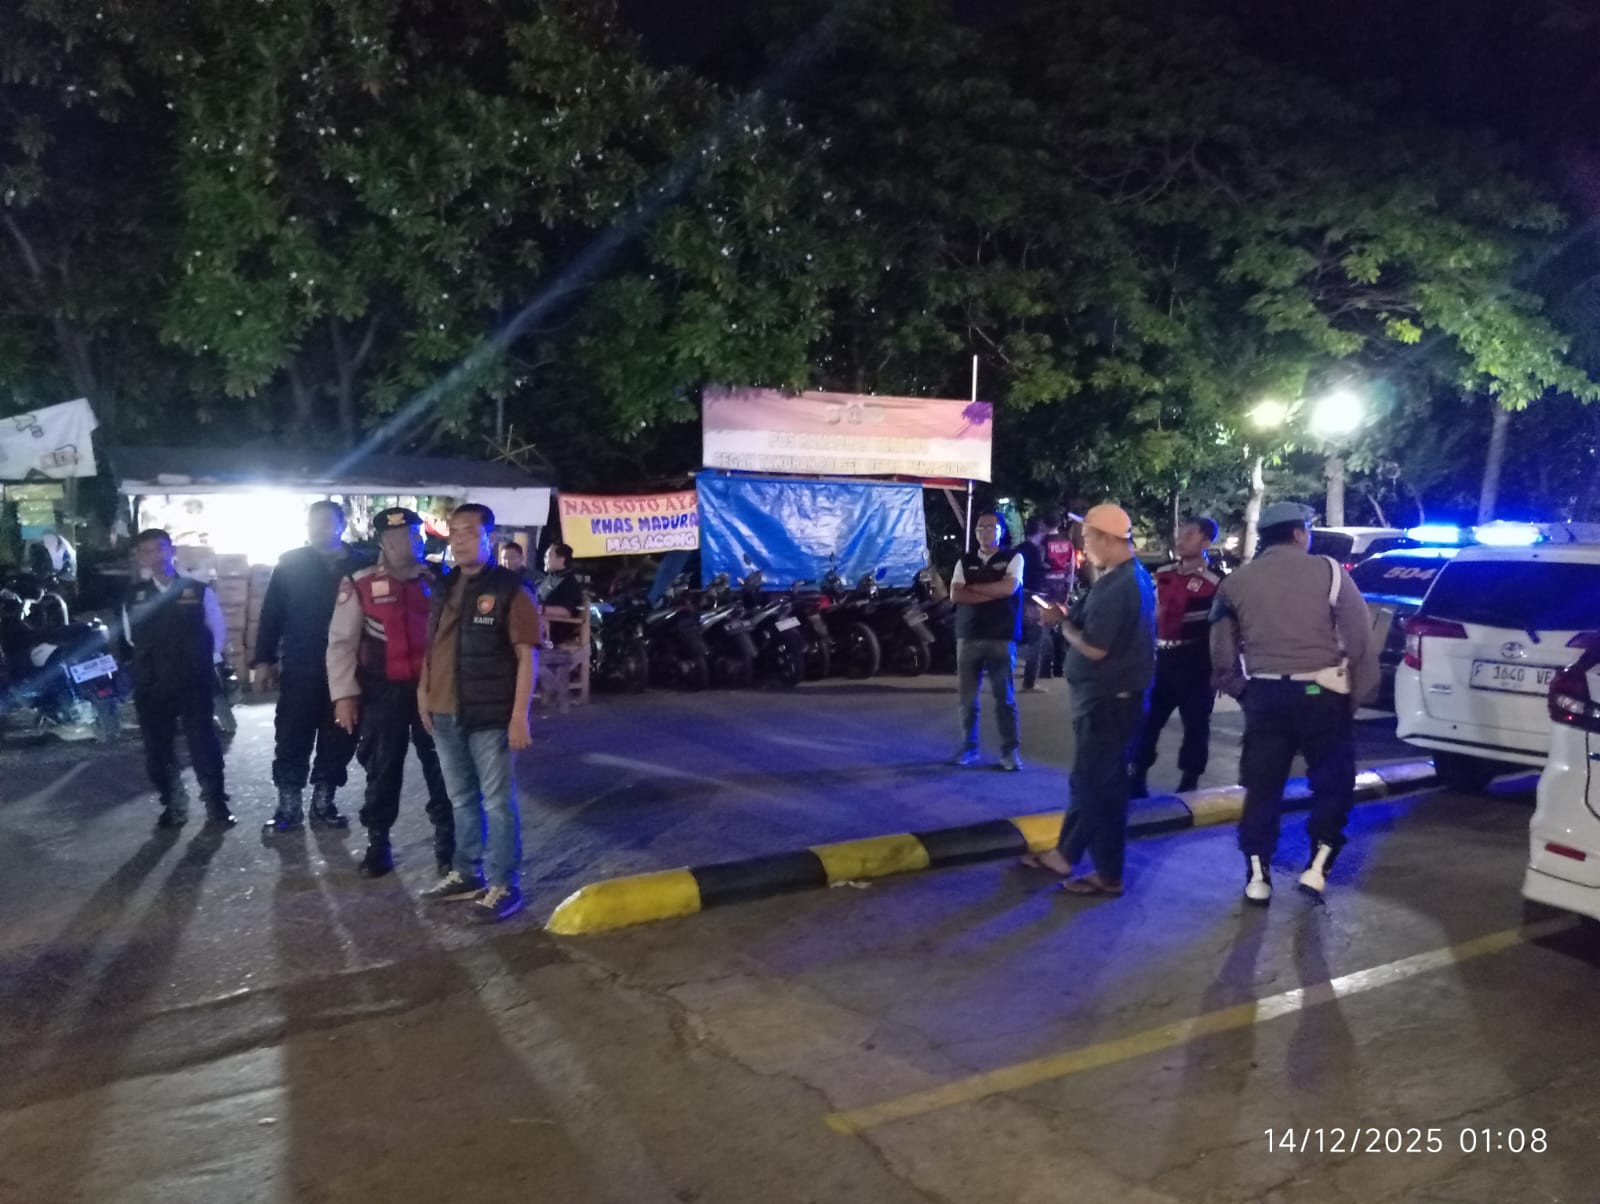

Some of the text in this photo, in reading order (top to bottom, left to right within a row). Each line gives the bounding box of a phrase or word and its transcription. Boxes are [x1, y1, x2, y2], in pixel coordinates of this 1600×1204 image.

[564, 500, 609, 515] NASI
[611, 499, 660, 513] SOTO
[590, 512, 698, 535] KHAS MADURA
[605, 537, 641, 553] MAS
